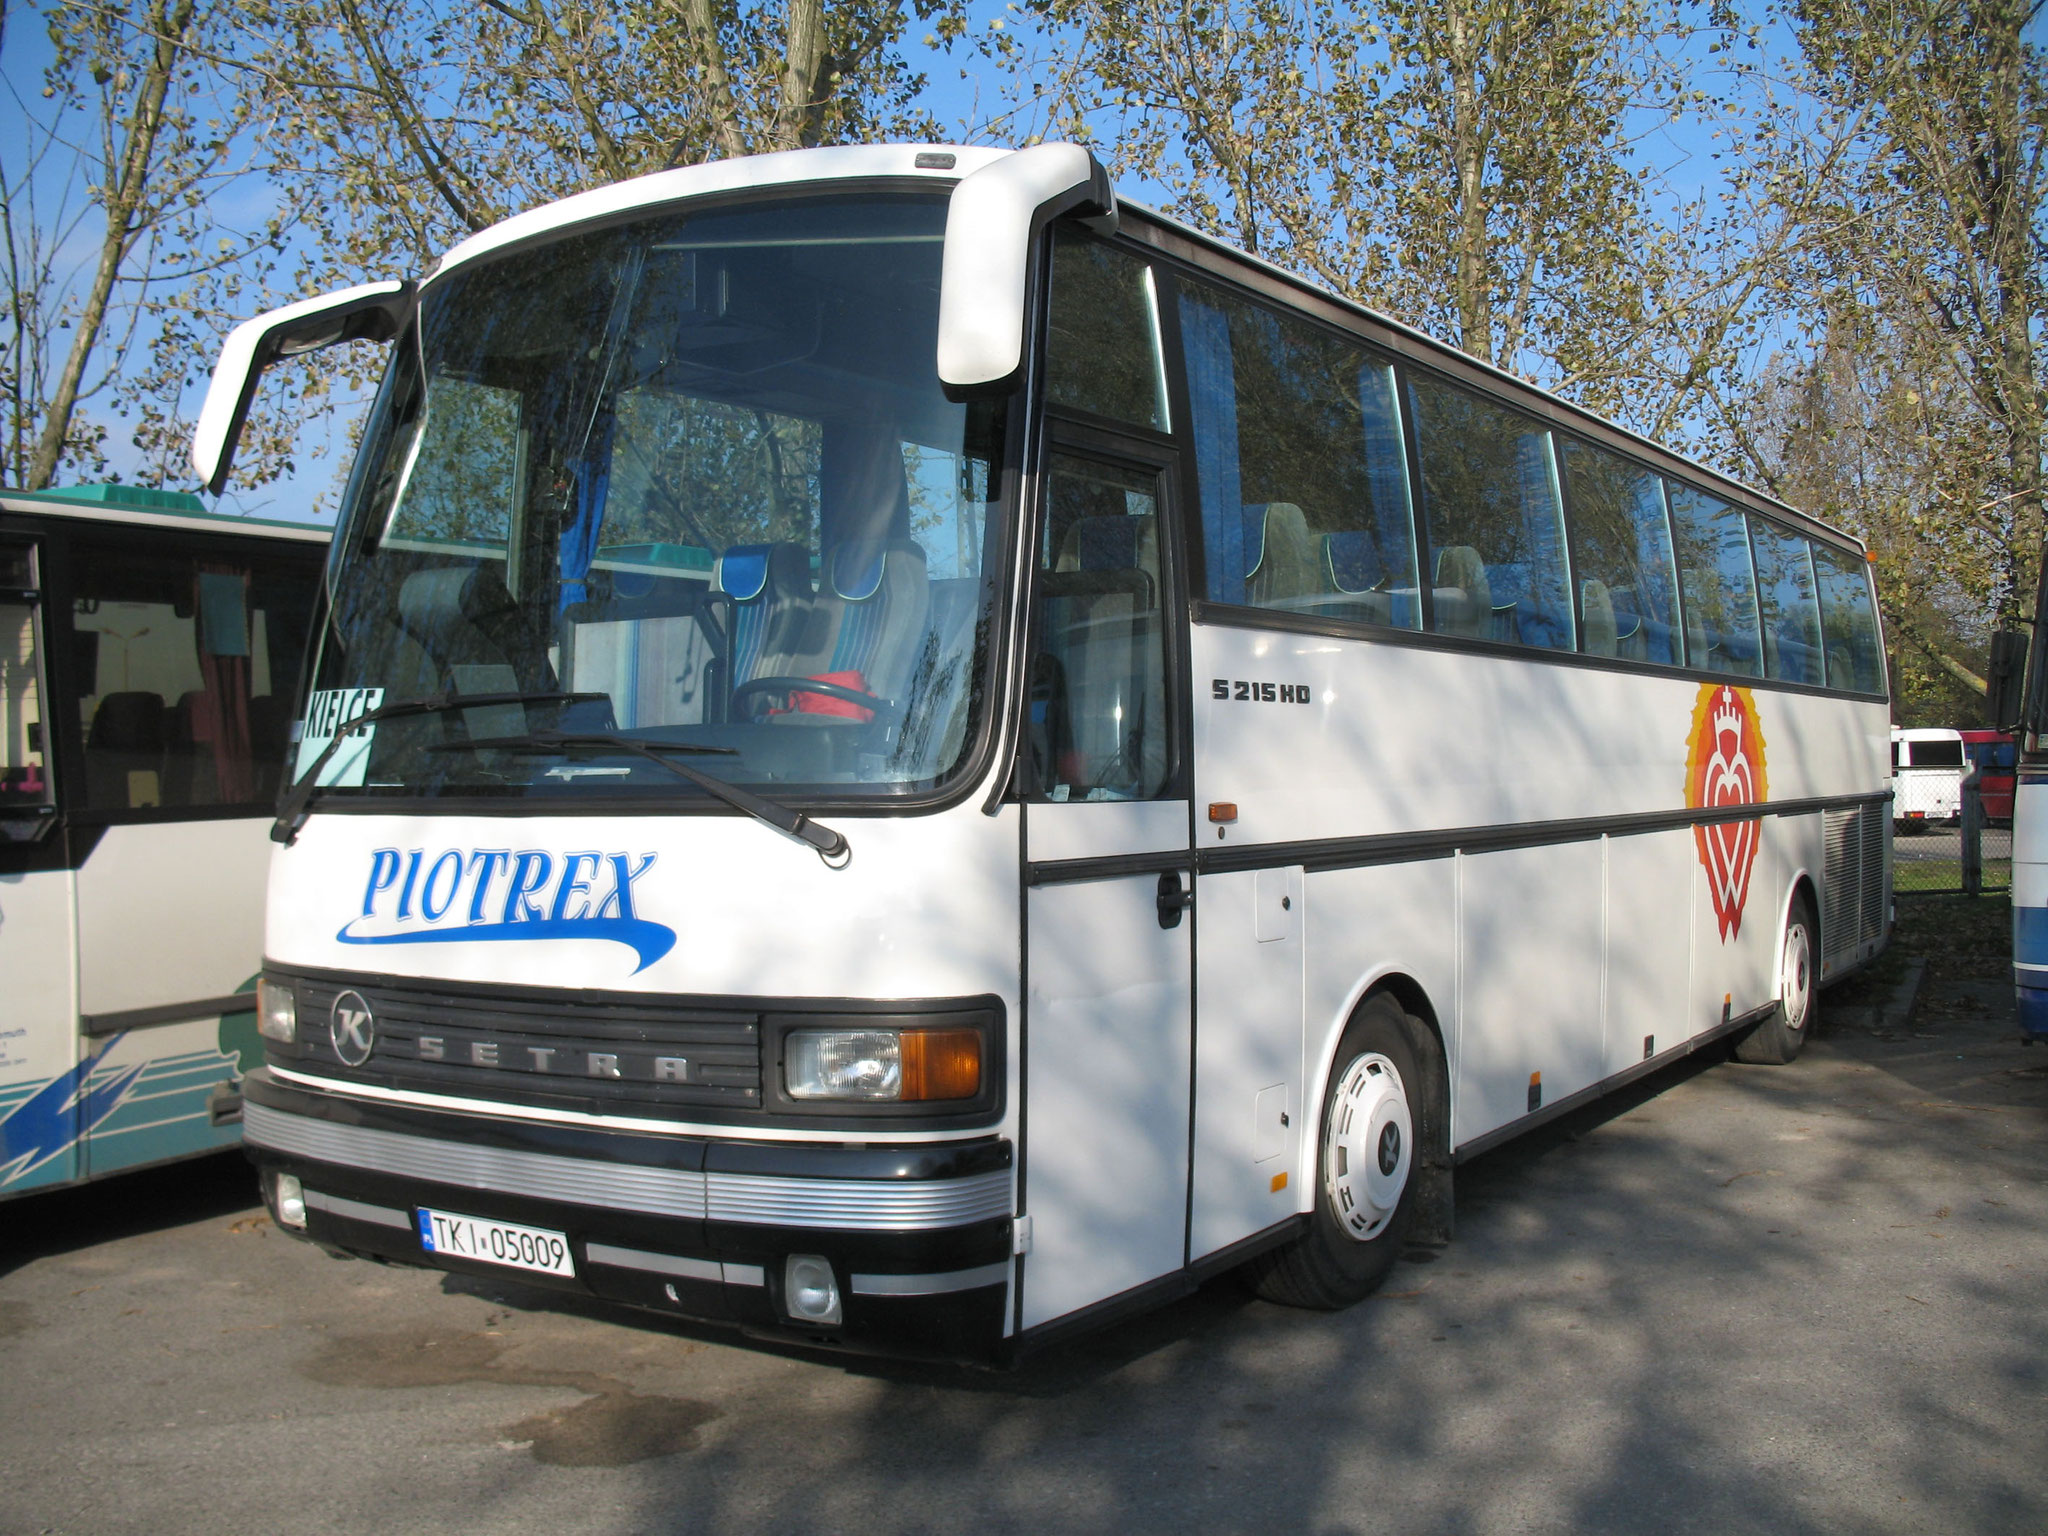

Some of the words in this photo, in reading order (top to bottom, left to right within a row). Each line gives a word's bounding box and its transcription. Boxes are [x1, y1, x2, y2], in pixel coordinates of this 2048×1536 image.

[1211, 678, 1229, 700] S
[1234, 681, 1276, 703] 215
[1280, 684, 1311, 704] HD
[361, 848, 658, 926] PIOTREX
[419, 1036, 688, 1081] SETRA
